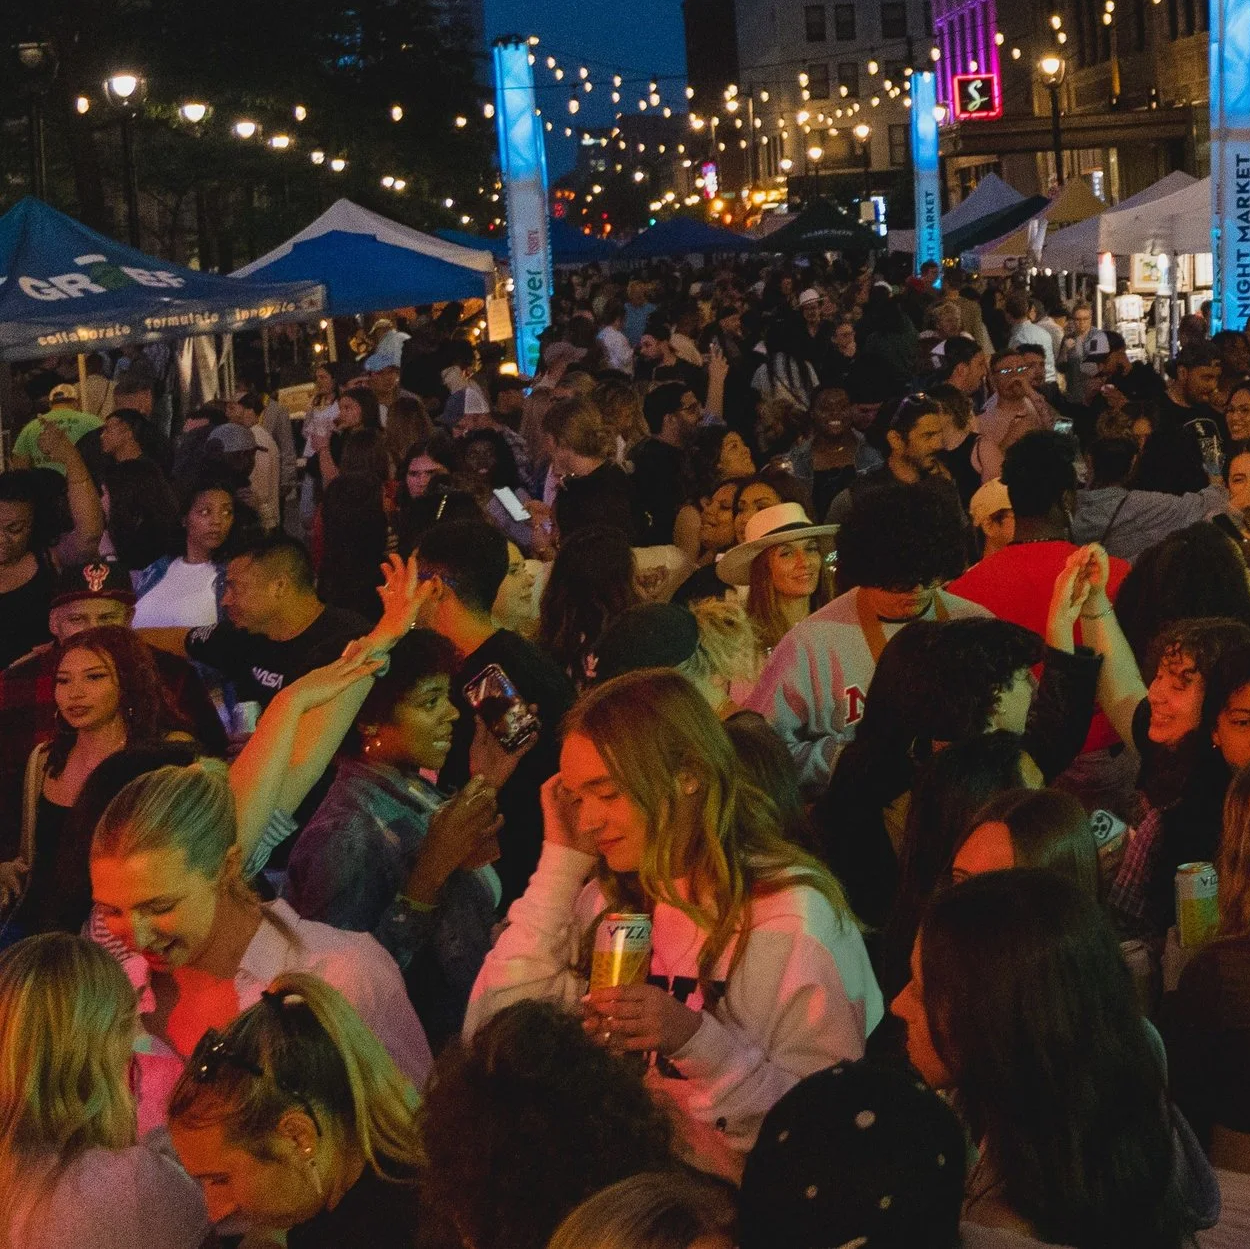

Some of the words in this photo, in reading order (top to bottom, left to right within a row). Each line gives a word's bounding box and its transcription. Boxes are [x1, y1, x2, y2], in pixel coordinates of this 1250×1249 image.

[925, 191, 935, 242] MARKET
[1236, 153, 1250, 243] MARKET
[1236, 249, 1250, 318] NIGHT
